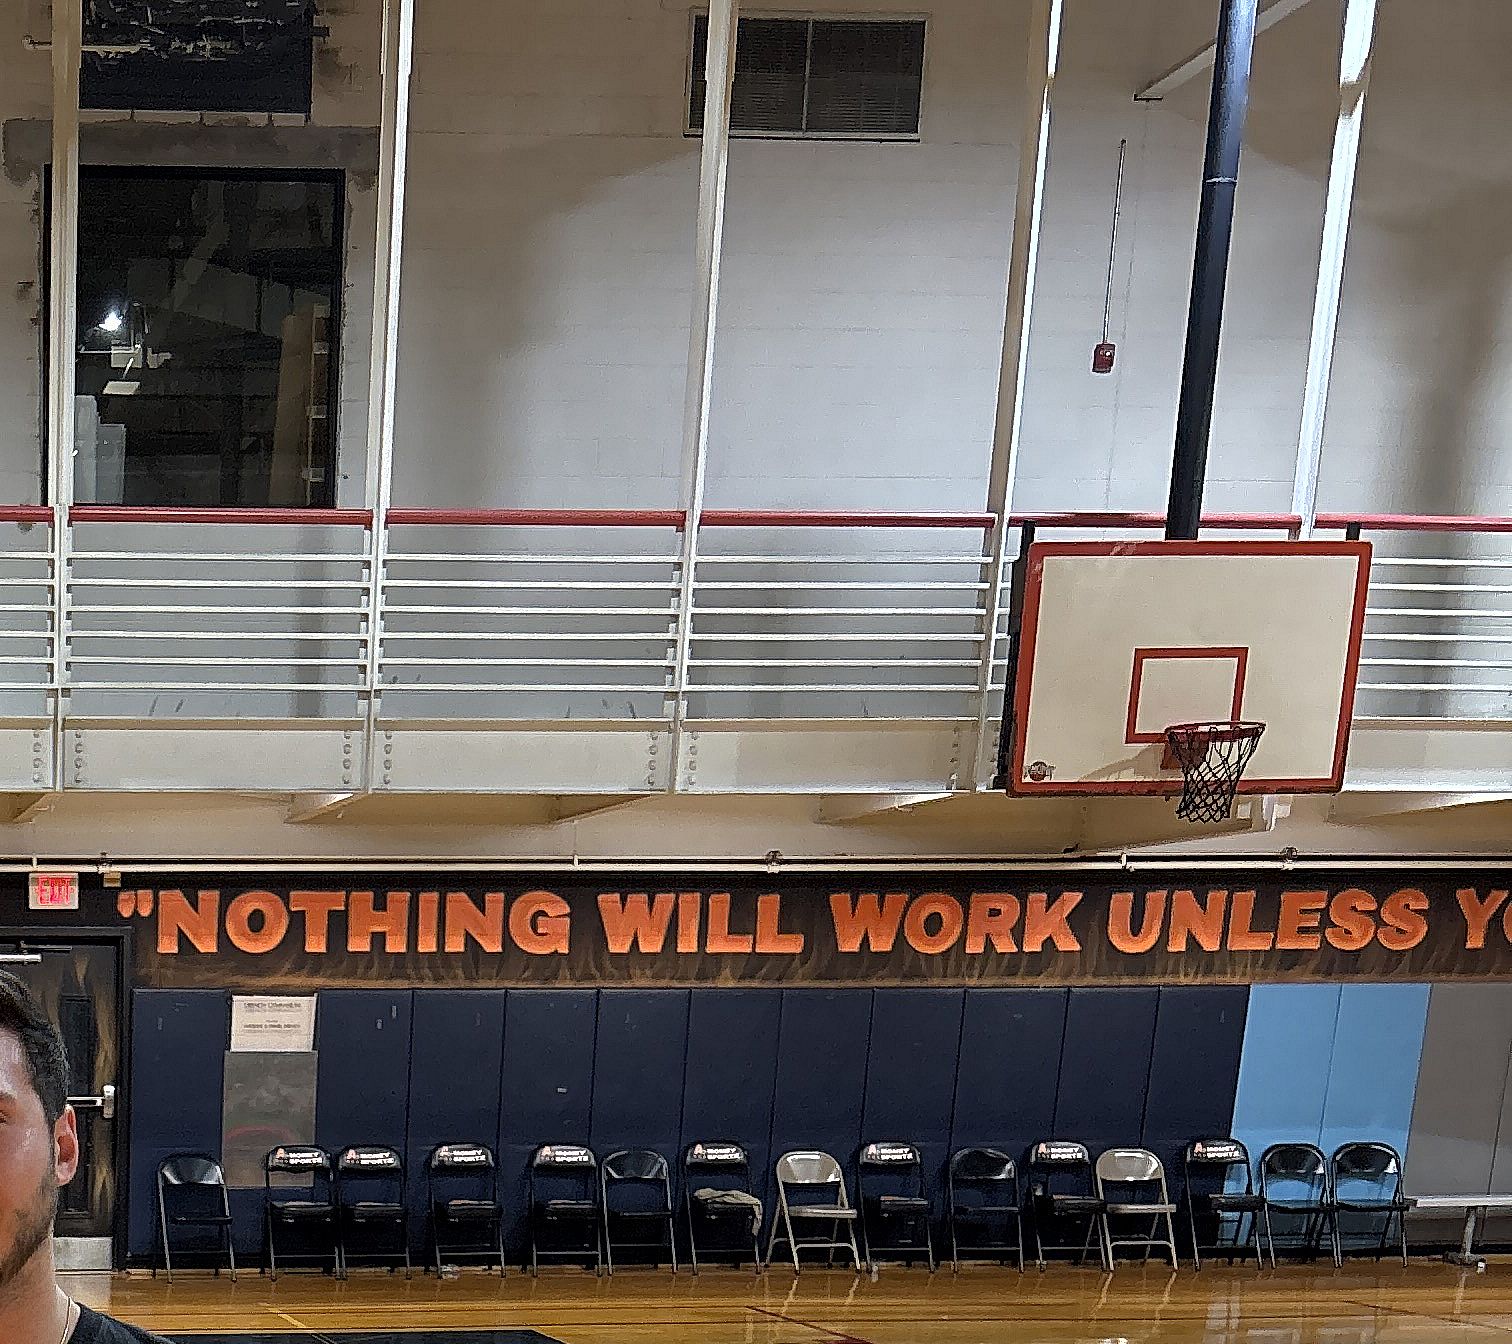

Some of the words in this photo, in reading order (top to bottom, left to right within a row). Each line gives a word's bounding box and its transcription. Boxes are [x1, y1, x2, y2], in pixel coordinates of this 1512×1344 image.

[38, 877, 72, 905] EXIT
[598, 893, 804, 953] WILL
[830, 892, 1080, 953] WORK
[1108, 889, 1428, 953] UNLESS
[1456, 888, 1512, 950] Y
